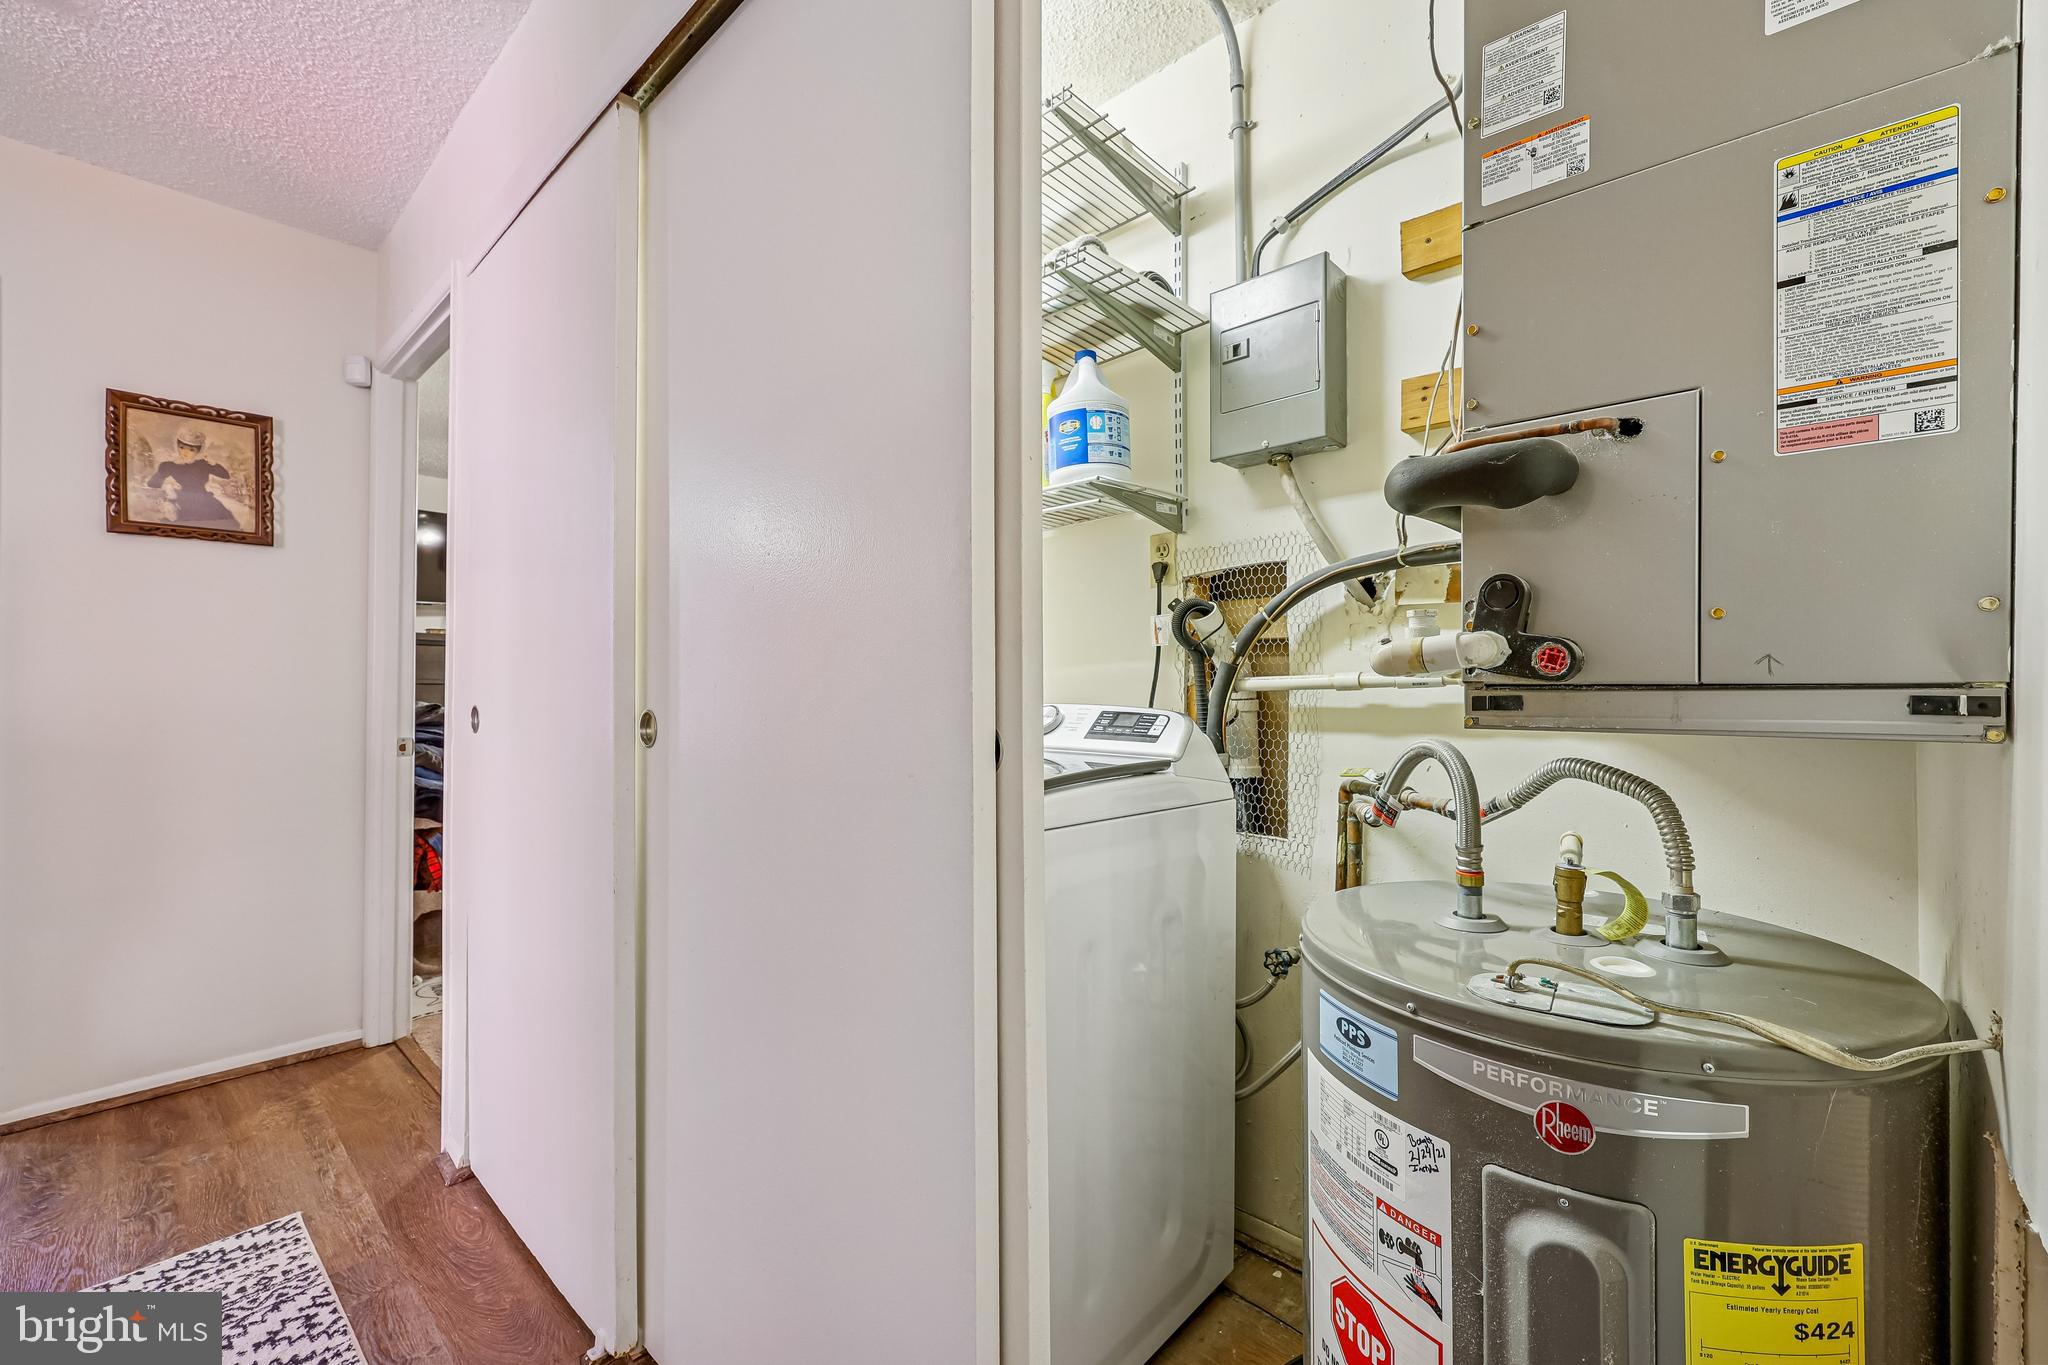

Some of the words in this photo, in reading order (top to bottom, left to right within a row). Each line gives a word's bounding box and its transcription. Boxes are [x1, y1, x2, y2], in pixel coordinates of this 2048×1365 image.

[1778, 11, 1804, 24] ASSEMBLED
[1811, 2, 1829, 12] MEXICO
[1780, 6, 1808, 19] ENGINEERED
[1514, 25, 1540, 39] WARNING
[1504, 46, 1548, 68] AVERTISSEMENT
[1507, 80, 1544, 98] ADVERTENCIA
[1544, 117, 1584, 135] AVERTISSEMENT
[1500, 142, 1521, 152] WARNING
[1805, 153, 1838, 166] EXPLOSION
[1839, 145, 1863, 156] HAZARD
[1868, 136, 1892, 147] RISQUE
[1893, 123, 1934, 140] D'EXPLOSION
[1814, 144, 1842, 156] CAUTION
[1879, 120, 1918, 136] ATTENTION
[1831, 173, 1858, 184] HAZARD
[1867, 163, 1893, 174] RISQUE
[1799, 211, 1819, 220] BEFORE
[1821, 202, 1852, 214] REPLACING
[1864, 191, 1893, 202] COMPLETE
[1896, 186, 1914, 194] THESE
[1842, 193, 1864, 204] NOTICE
[1870, 188, 1882, 196] AVIS
[1812, 234, 1846, 246] REMPLACER
[1885, 219, 1905, 228] SUIVRE
[1796, 281, 1820, 289] REQUIRES
[1831, 271, 1860, 281] FOLLOWING
[1873, 264, 1893, 272] PROPER
[1817, 264, 1858, 278] INSTALLATION
[1863, 253, 1906, 267] INSTALLATION
[1790, 321, 1823, 331] INSTALLATION
[1824, 313, 1859, 324] INSTRUCTIONS
[1873, 304, 1903, 314] ADDITIONAL
[1904, 296, 1940, 307] INFORMATION
[1849, 372, 1882, 382] WARNING
[1825, 393, 1852, 401] SERVICE
[1858, 386, 1895, 396] ENTRETIEN
[1341, 1019, 1366, 1046] PPS
[1472, 1060, 1659, 1116] PERFORMANCE
[1541, 1102, 1592, 1145] Rheem
[1390, 1209, 1437, 1244] DANGER
[1412, 1267, 1425, 1280] HOT
[1694, 1248, 1852, 1278] ENERGYGUIDE
[1726, 1304, 1758, 1313] Estimated
[1335, 1297, 1386, 1365] STOP
[1794, 1321, 1855, 1342] $424
